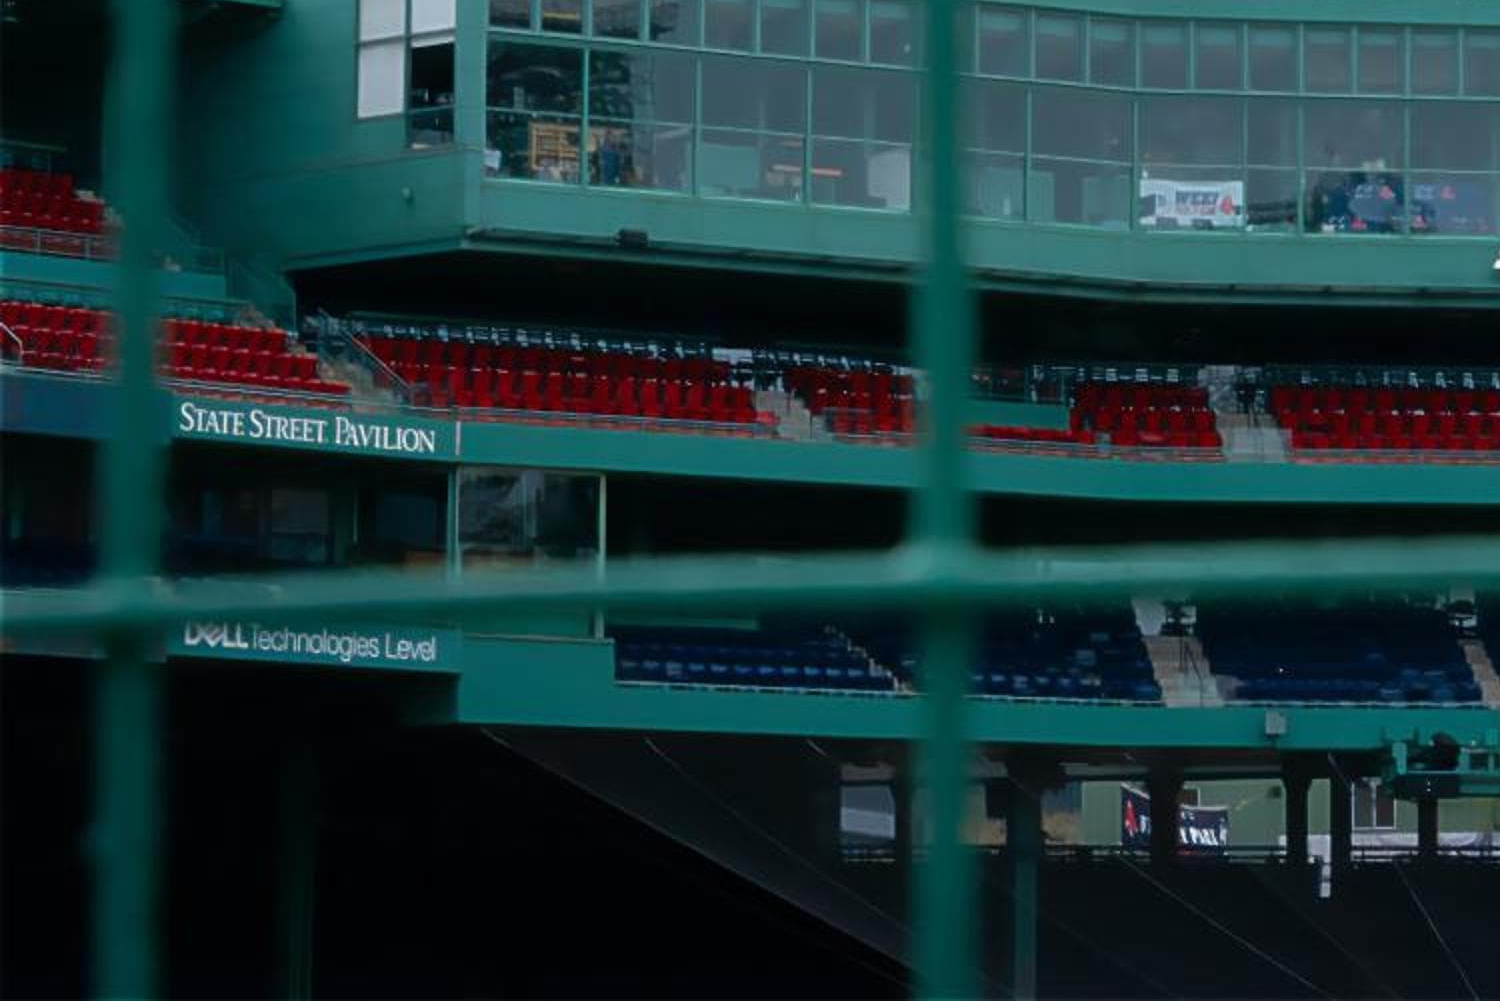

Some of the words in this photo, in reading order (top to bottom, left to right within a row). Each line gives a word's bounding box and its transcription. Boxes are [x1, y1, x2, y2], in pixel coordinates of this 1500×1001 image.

[179, 402, 245, 437] STATE
[250, 409, 327, 444] STREET
[335, 416, 436, 454] PAVILION
[184, 622, 248, 649] DELL
[251, 624, 380, 662] Technologies
[385, 631, 437, 661] Level
